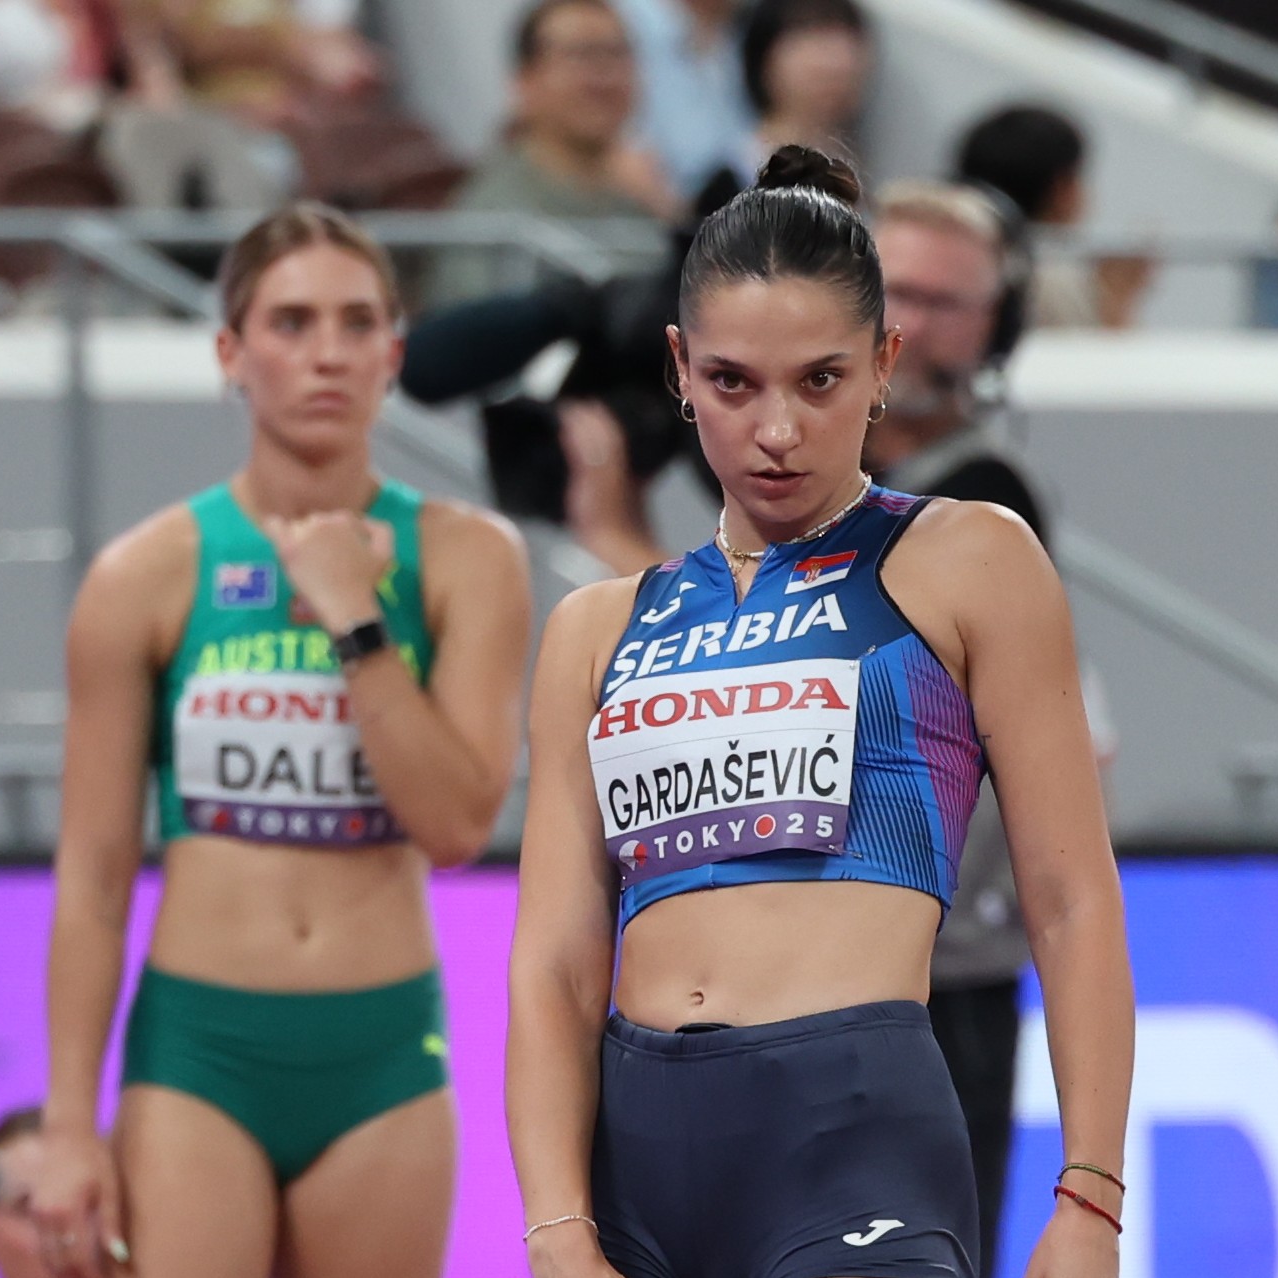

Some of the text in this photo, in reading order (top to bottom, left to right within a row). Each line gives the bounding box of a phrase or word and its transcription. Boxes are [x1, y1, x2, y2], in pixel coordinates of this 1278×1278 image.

[195, 629, 341, 675] AUSTR
[606, 593, 848, 694] SERBIA
[189, 689, 349, 724] HON
[593, 677, 850, 741] HONDA
[607, 734, 838, 831] GARDAŠEVIĆ
